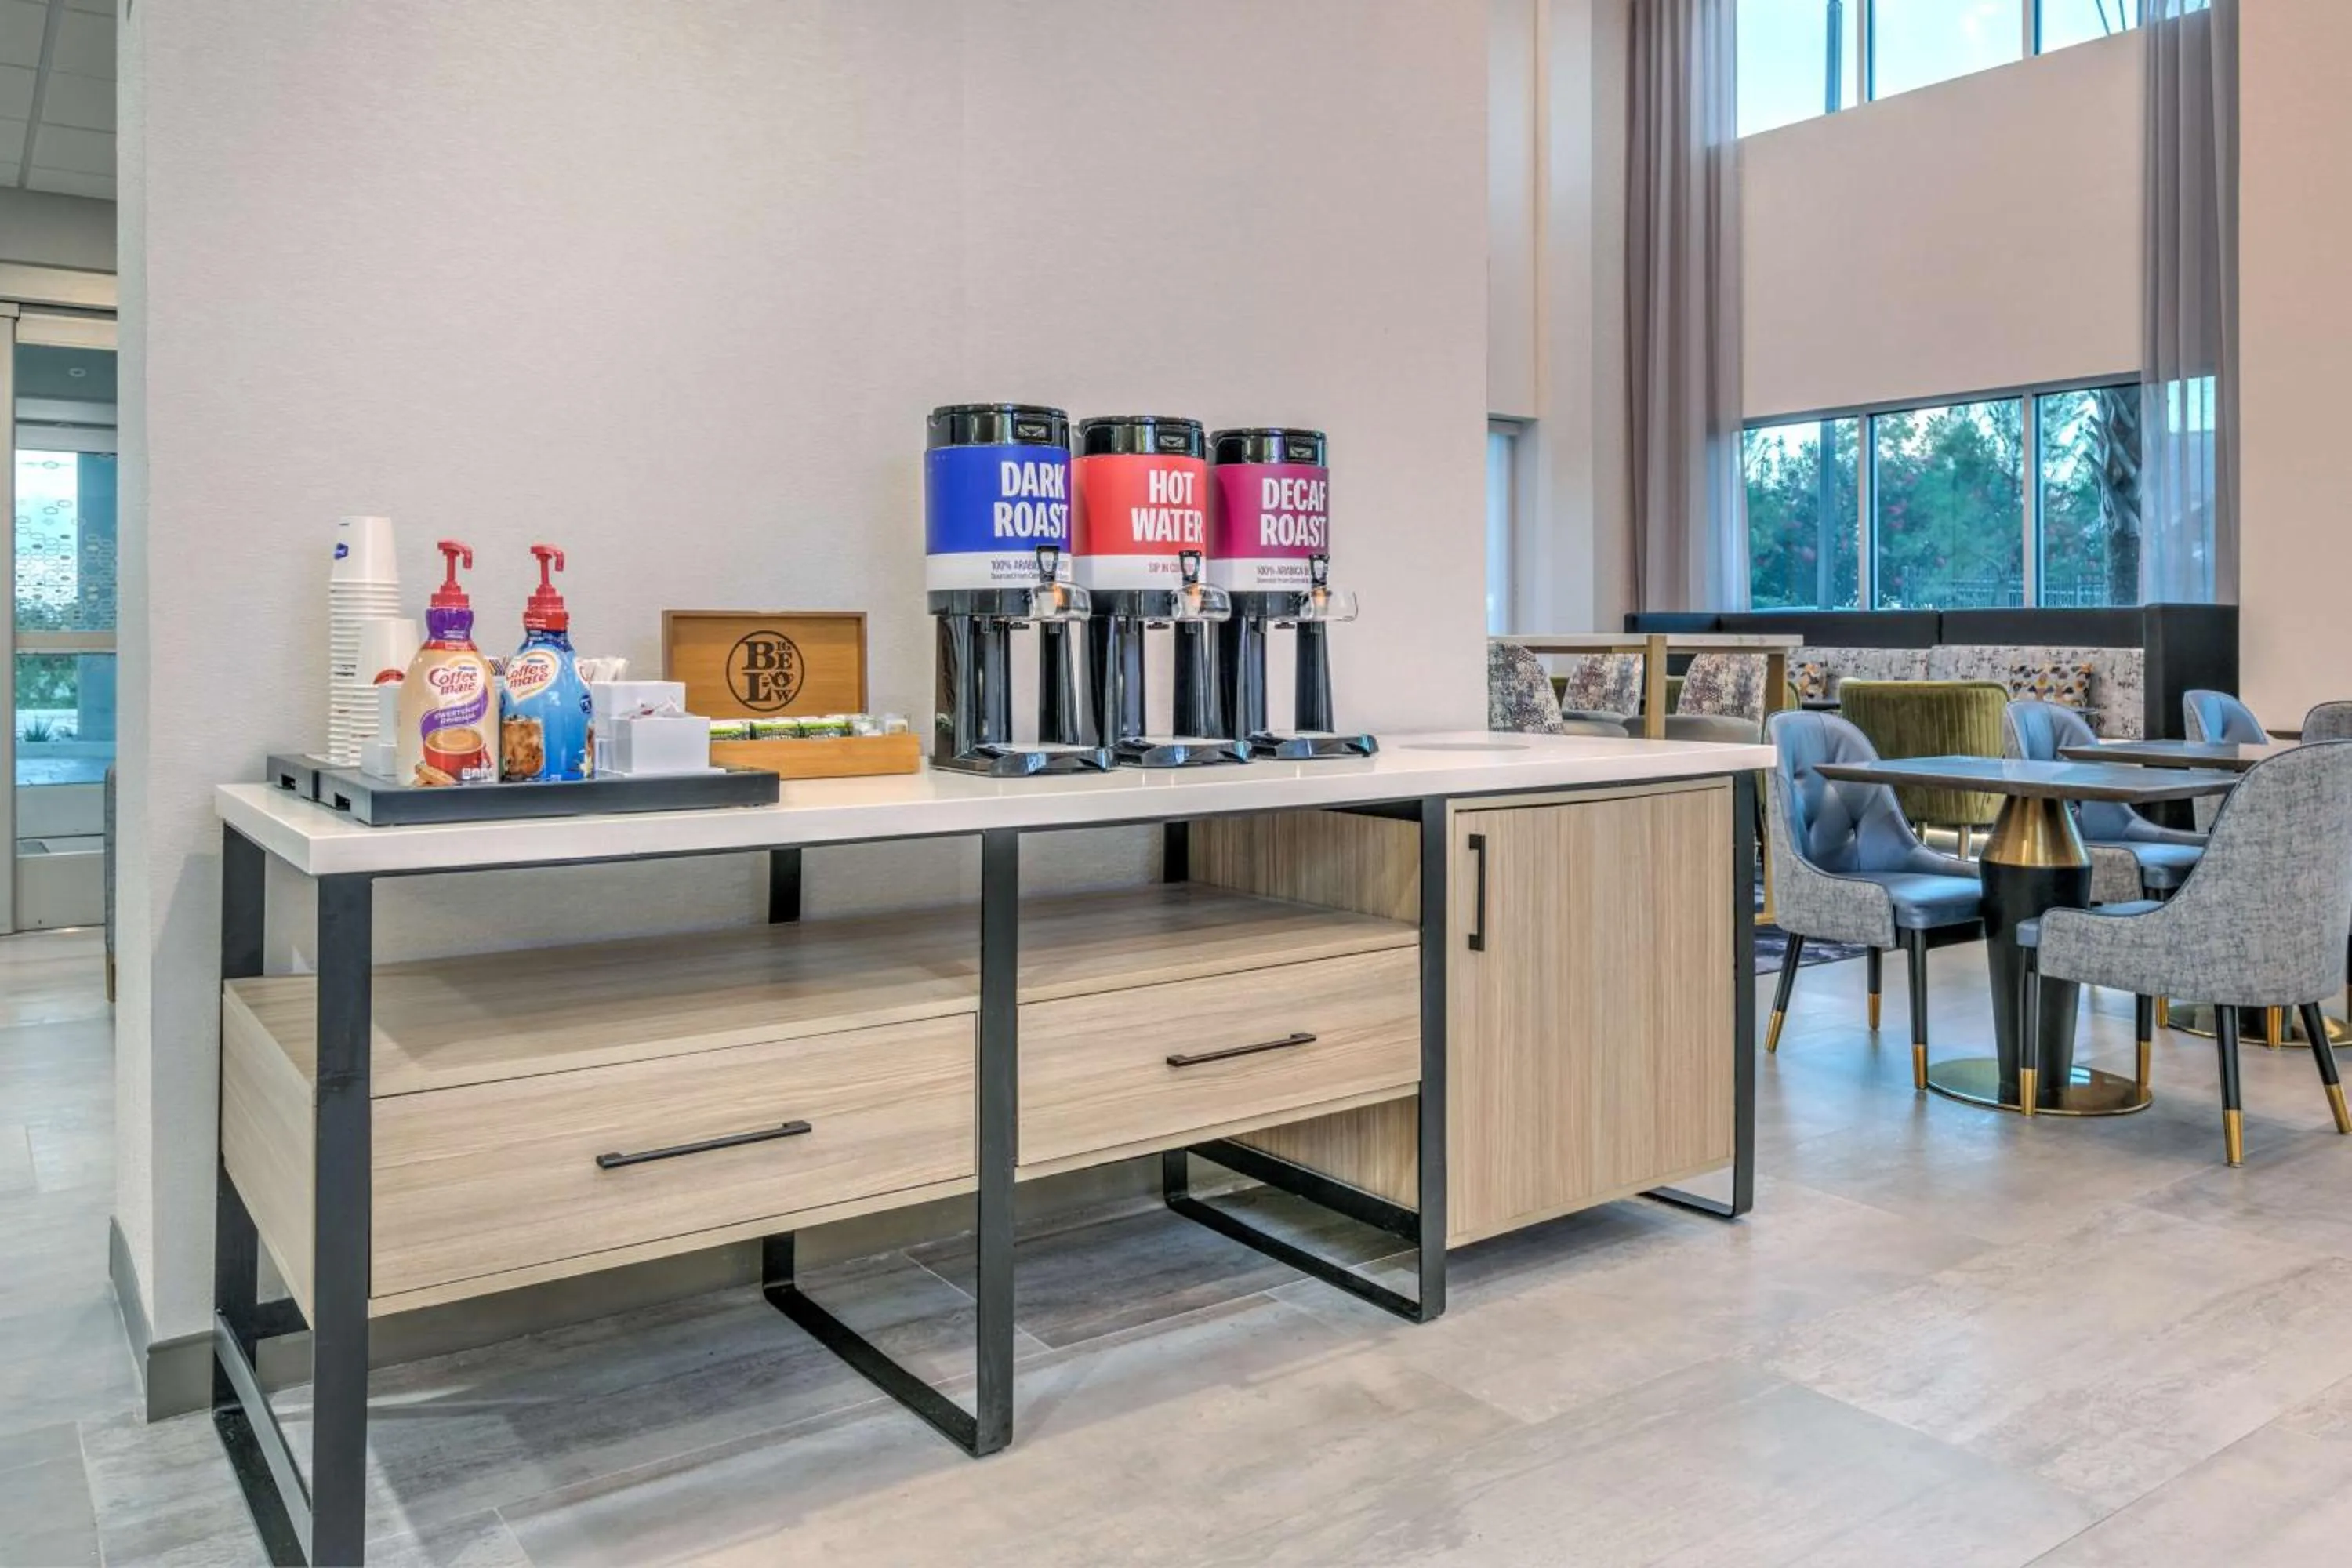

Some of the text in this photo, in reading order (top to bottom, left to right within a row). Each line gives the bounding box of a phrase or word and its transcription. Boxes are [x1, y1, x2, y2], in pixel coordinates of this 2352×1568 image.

[1000, 460, 1065, 499] DARK
[1149, 470, 1195, 505] HOT
[1261, 477, 1326, 512] DECAF
[993, 501, 1068, 539] ROAST
[1131, 507, 1203, 543] WATER
[1260, 514, 1326, 547] ROAST
[429, 667, 477, 688] Coffee
[440, 682, 475, 695] mate
